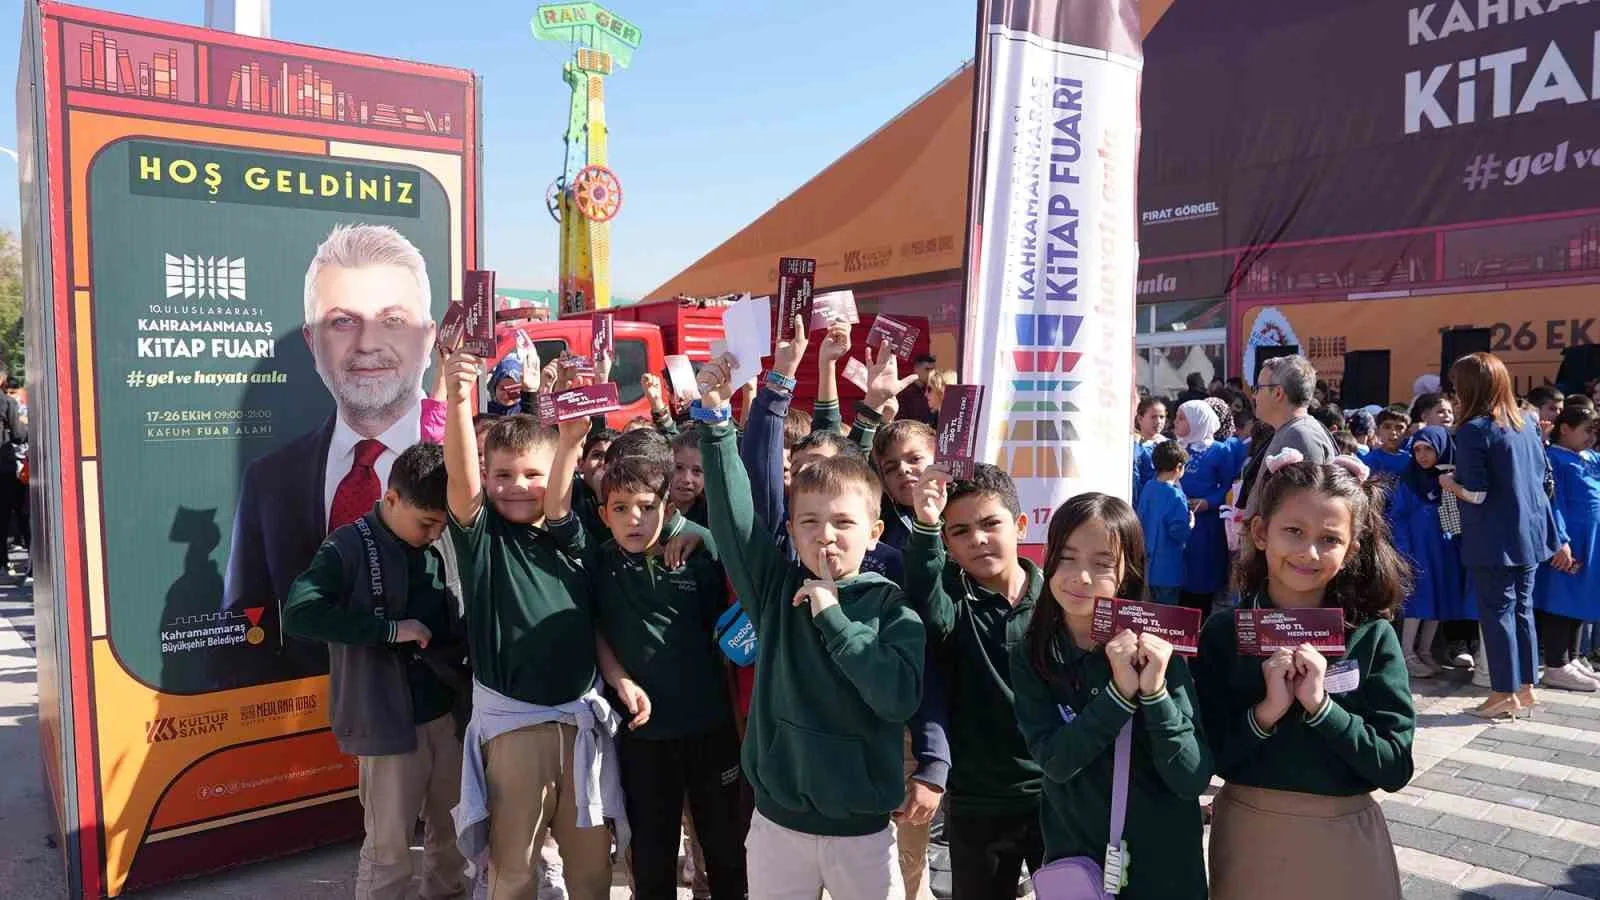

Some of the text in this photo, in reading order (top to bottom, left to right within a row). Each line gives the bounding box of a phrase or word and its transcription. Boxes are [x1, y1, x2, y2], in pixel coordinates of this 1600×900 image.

[1049, 76, 1083, 184] FUARI
[139, 156, 414, 204] HOŞ GELDİNİZ
[1142, 201, 1218, 221] FIRAT GÖRGEL
[137, 318, 273, 336] KAHRAMANMARAŞ
[211, 337, 275, 358] FUARI
[197, 427, 229, 436] FUAR
[365, 538, 383, 597] ARMOUR
[1131, 616, 1149, 625] 200
[1275, 623, 1292, 631] 200
[161, 623, 246, 641] Kahramanmaraş
[728, 620, 753, 649] Reebo
[161, 633, 246, 653] Büyükşehir Belediyesi
